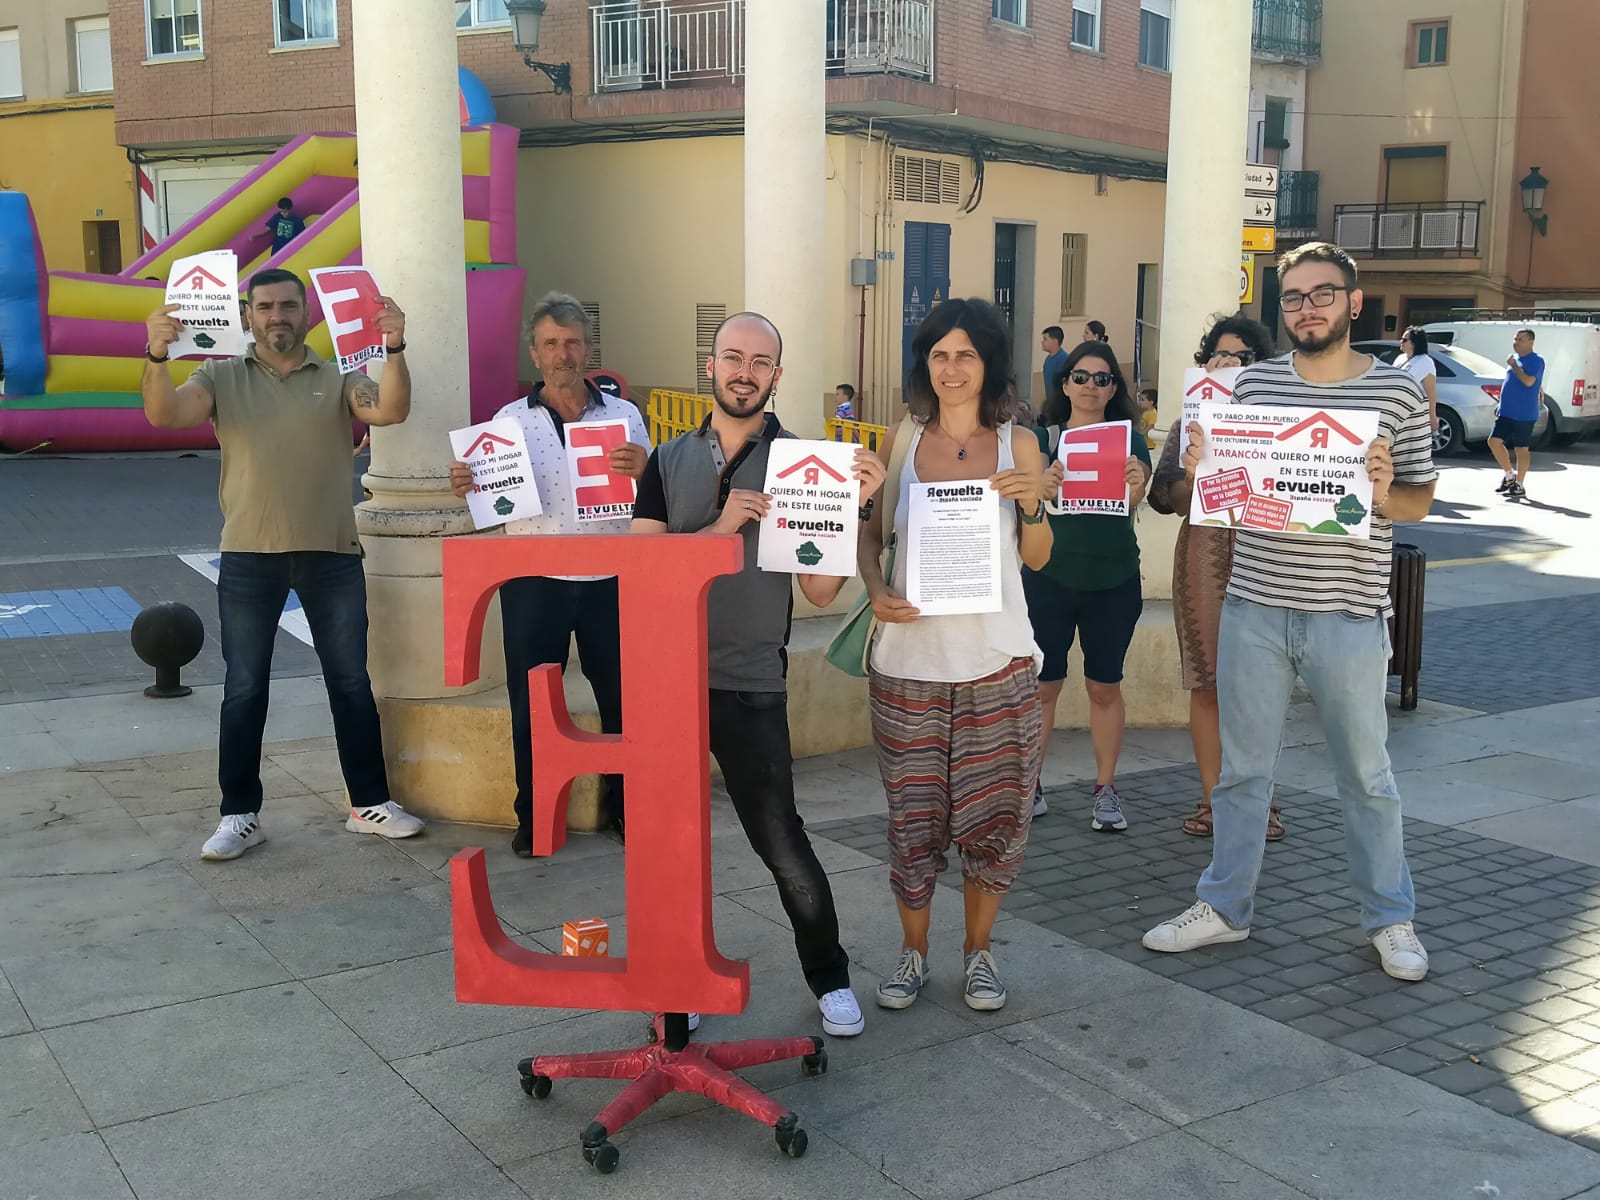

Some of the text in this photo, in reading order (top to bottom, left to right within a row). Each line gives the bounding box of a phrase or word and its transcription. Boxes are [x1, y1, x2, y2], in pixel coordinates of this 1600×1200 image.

[180, 317, 230, 327] evuelta
[341, 346, 384, 366] REVUELTA
[498, 451, 522, 461] HOGAR
[1213, 448, 1366, 464] TARANCÓN QUIERO MI HOGAR
[480, 468, 495, 476] ESTE
[497, 462, 519, 472] LUGAR
[1280, 467, 1355, 479] EN ESTE LUGAR
[770, 487, 804, 497] QUIERO
[820, 490, 852, 500] HOGAR
[792, 502, 811, 511] ESTE
[814, 503, 842, 512] LUGAR
[1062, 500, 1125, 509] REVUELTA
